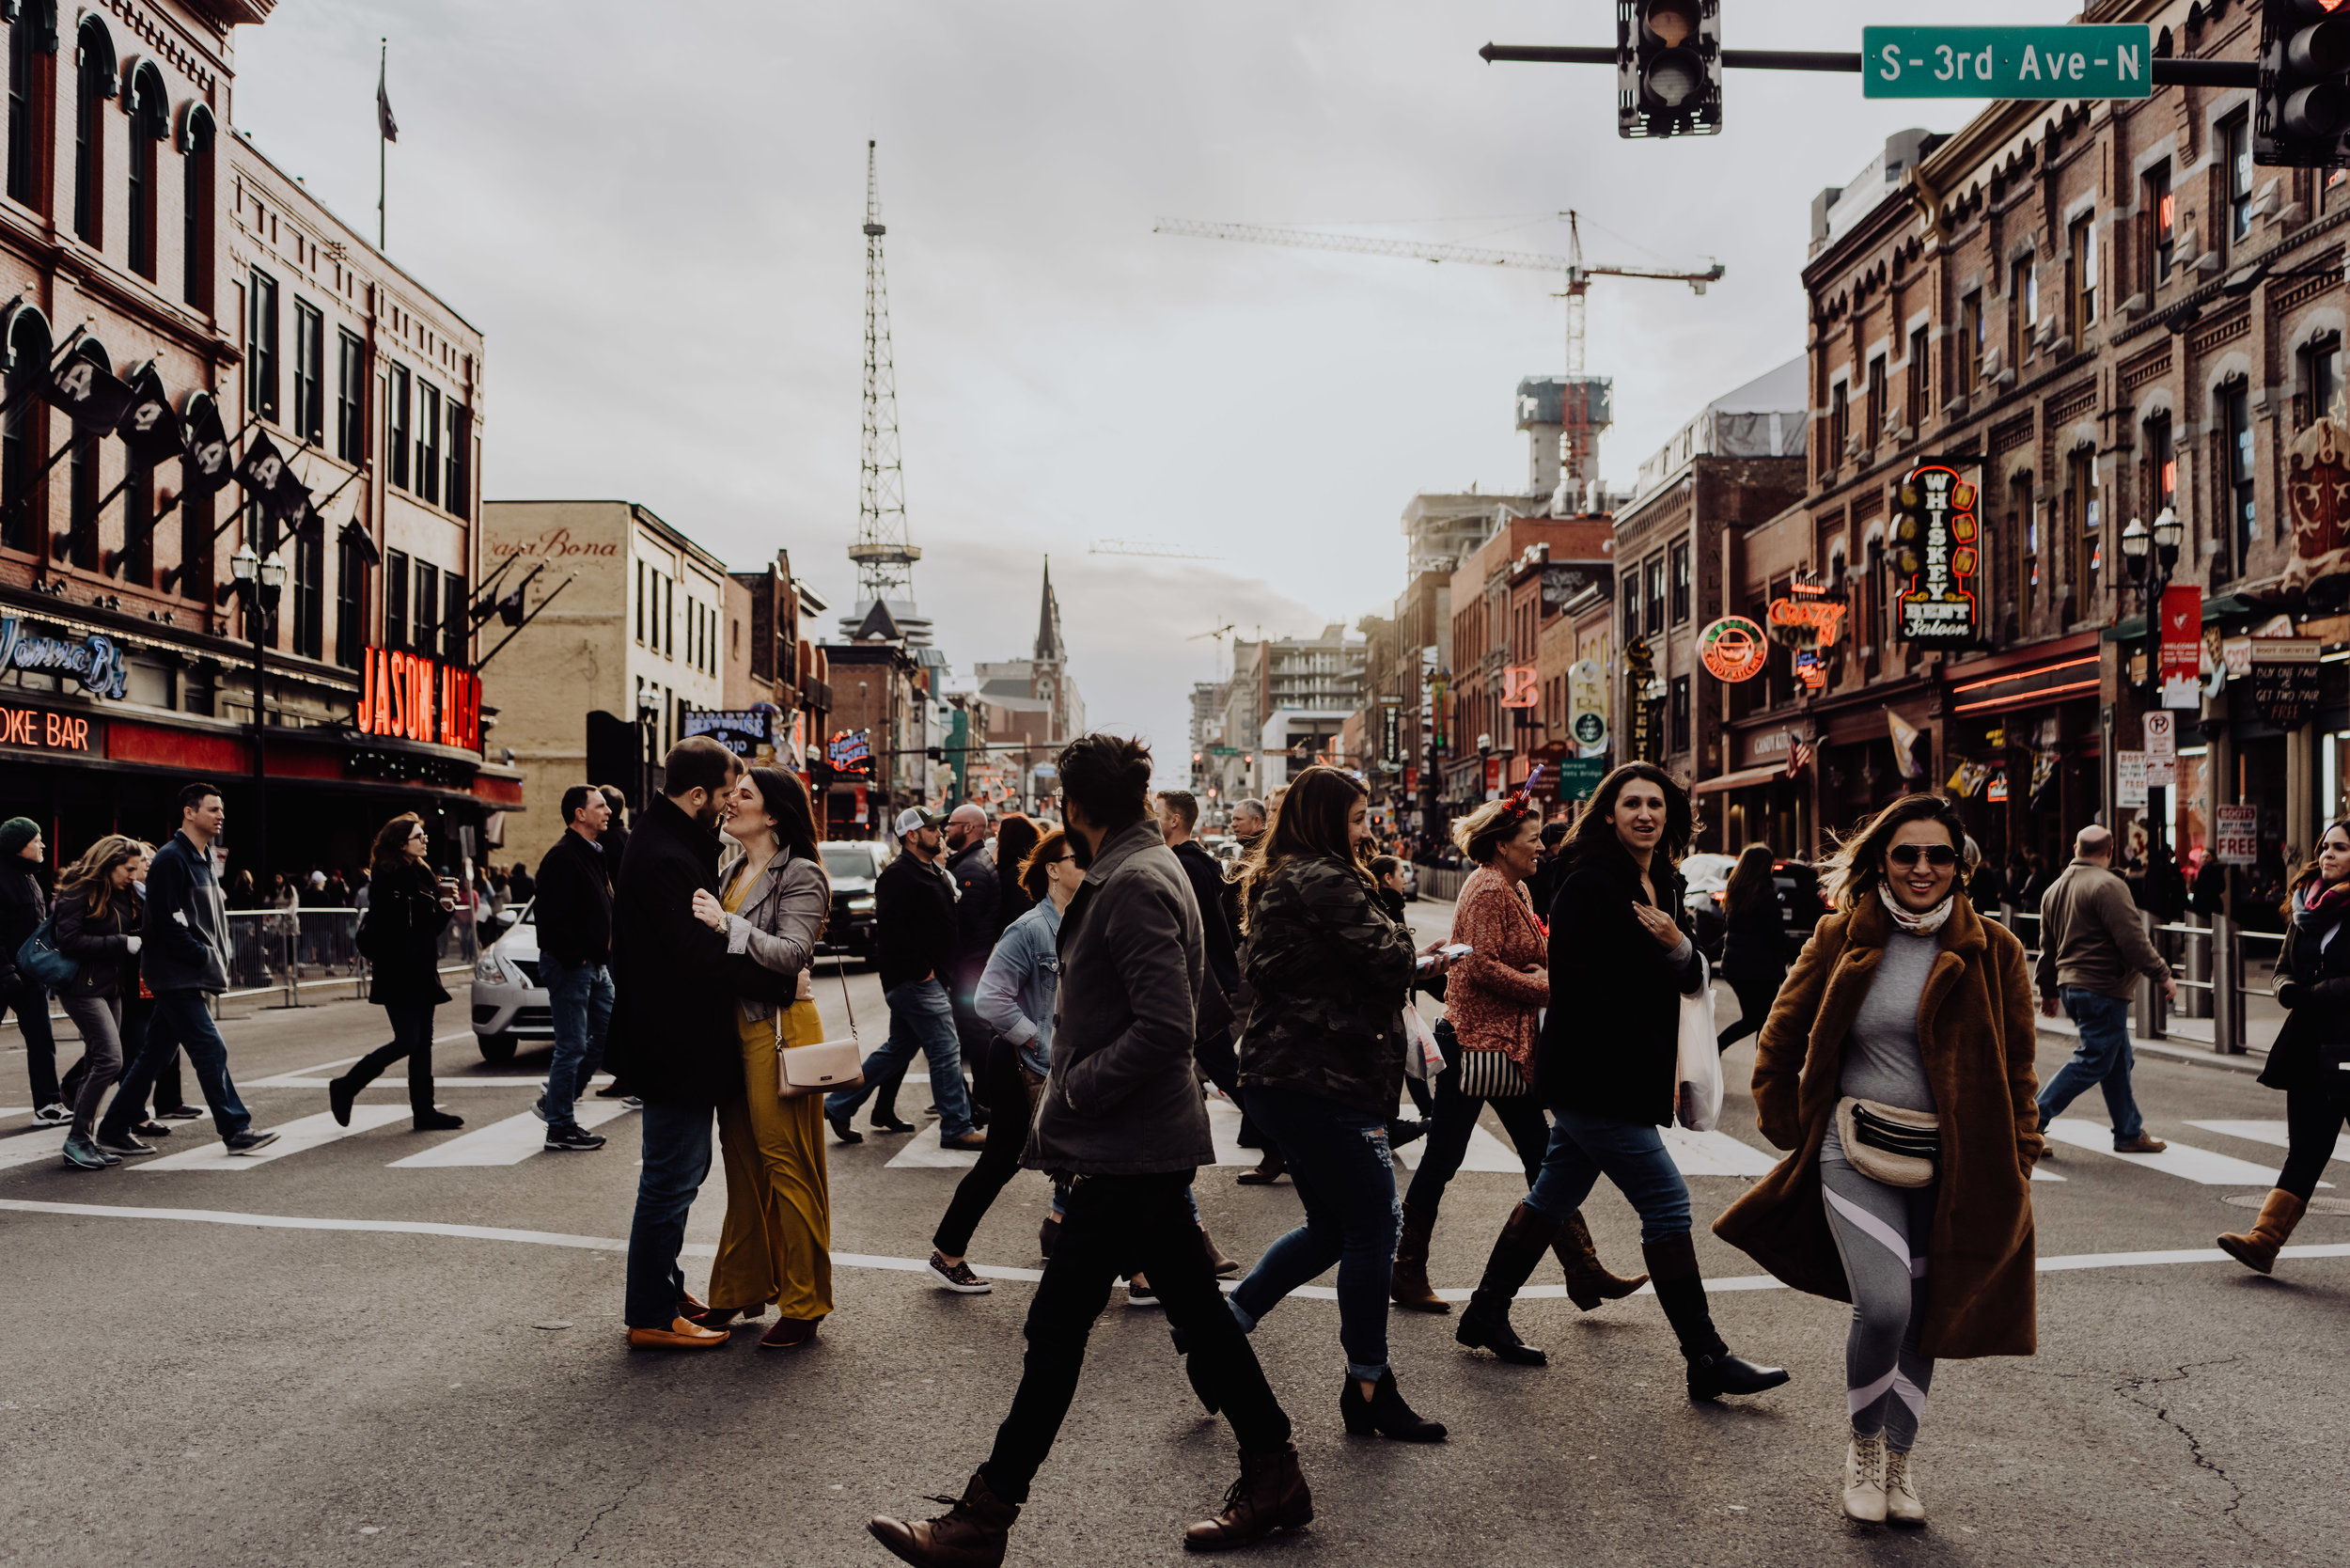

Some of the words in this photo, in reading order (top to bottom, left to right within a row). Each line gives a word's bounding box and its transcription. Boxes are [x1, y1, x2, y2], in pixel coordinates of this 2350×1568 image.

[538, 526, 619, 557] Bona
[1924, 473, 1950, 601] WHISKEY
[1768, 598, 1847, 626] CRAZY
[1904, 603, 1970, 619] BENT
[1705, 521, 1722, 745] VALEINE
[1773, 622, 1837, 647] TOWN
[1904, 619, 1969, 637] Saloon
[2257, 666, 2275, 678] BUY
[2297, 666, 2319, 678] PAIR
[357, 643, 433, 743] JASON
[2276, 689, 2295, 701] TWO
[2298, 689, 2320, 701] PAIR
[47, 712, 88, 751] BAR
[684, 718, 764, 739] BREWHOUSE
[721, 740, 748, 755] OJO
[1754, 733, 1776, 755] CANDY
[2221, 809, 2253, 819] BOOTS
[2218, 838, 2256, 855] FREE
